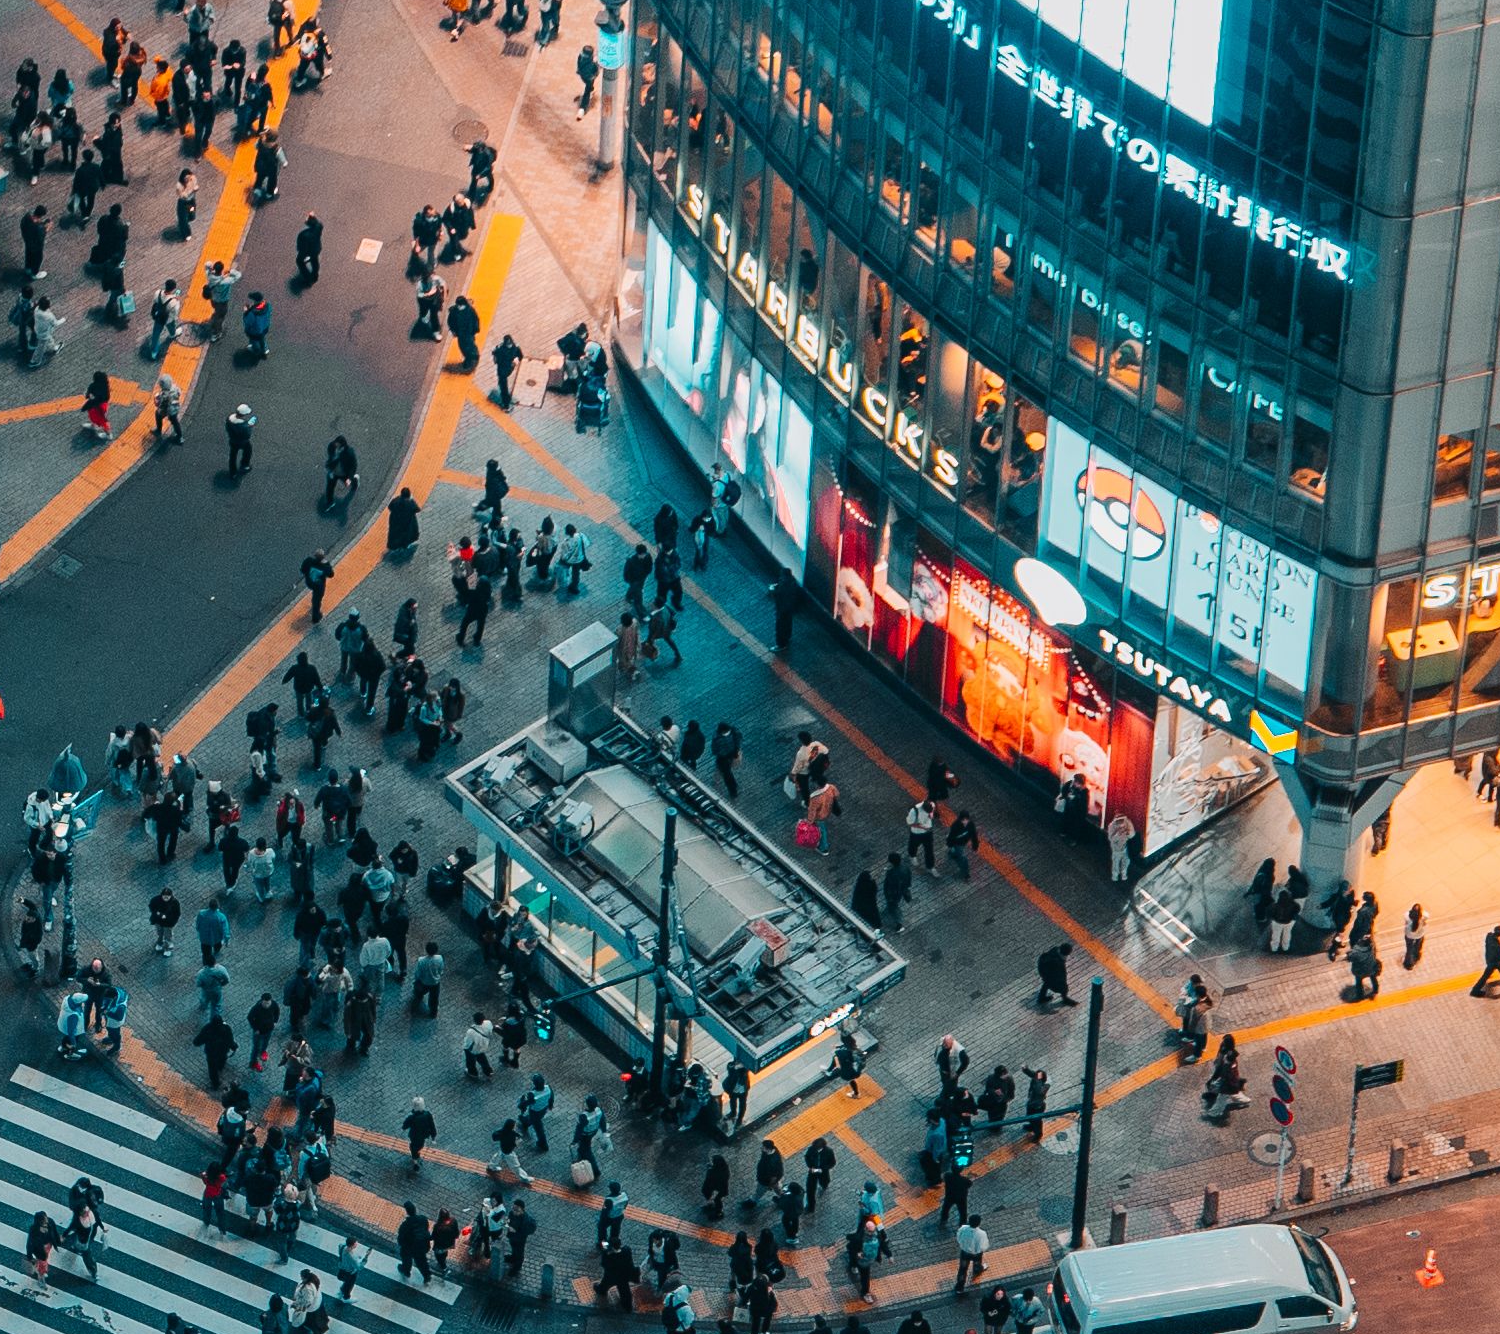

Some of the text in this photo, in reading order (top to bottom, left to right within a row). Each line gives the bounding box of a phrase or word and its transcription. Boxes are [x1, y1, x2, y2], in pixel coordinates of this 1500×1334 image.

[686, 183, 959, 486] STARBUCKS
[1192, 549, 1298, 625] LOUNGE
[1099, 630, 1232, 723] TSUTAYA
